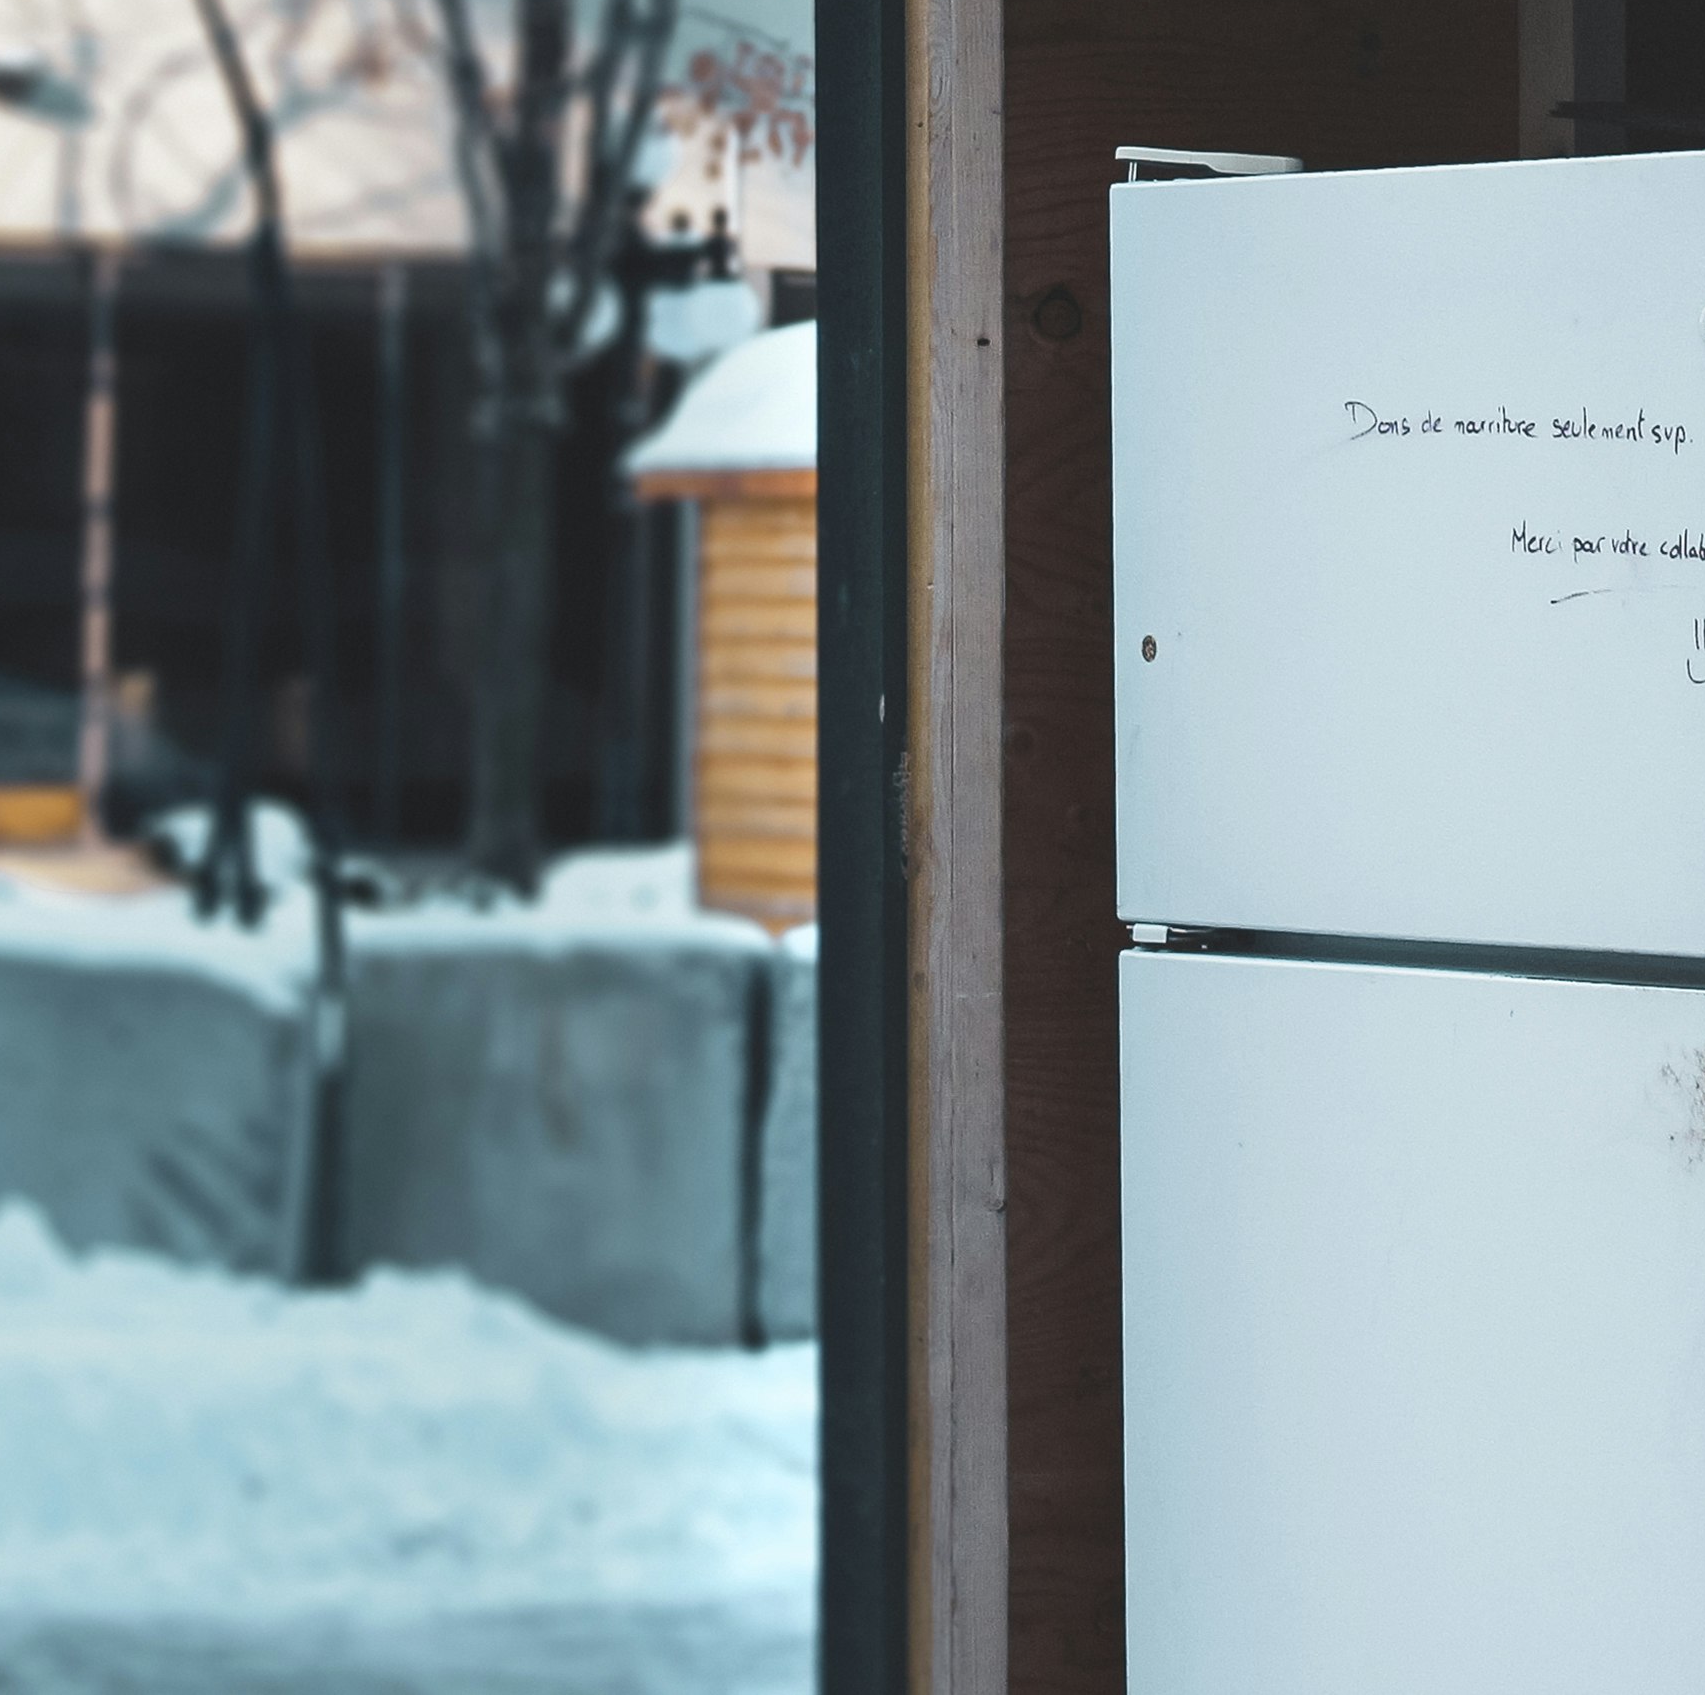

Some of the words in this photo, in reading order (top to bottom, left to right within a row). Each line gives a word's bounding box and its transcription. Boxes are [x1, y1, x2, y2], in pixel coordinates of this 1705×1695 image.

[1344, 400, 1411, 441] Dons
[1421, 409, 1443, 434] de
[1552, 407, 1646, 441] seulement
[1510, 520, 1564, 555] Merci
[1611, 529, 1649, 557] votre
